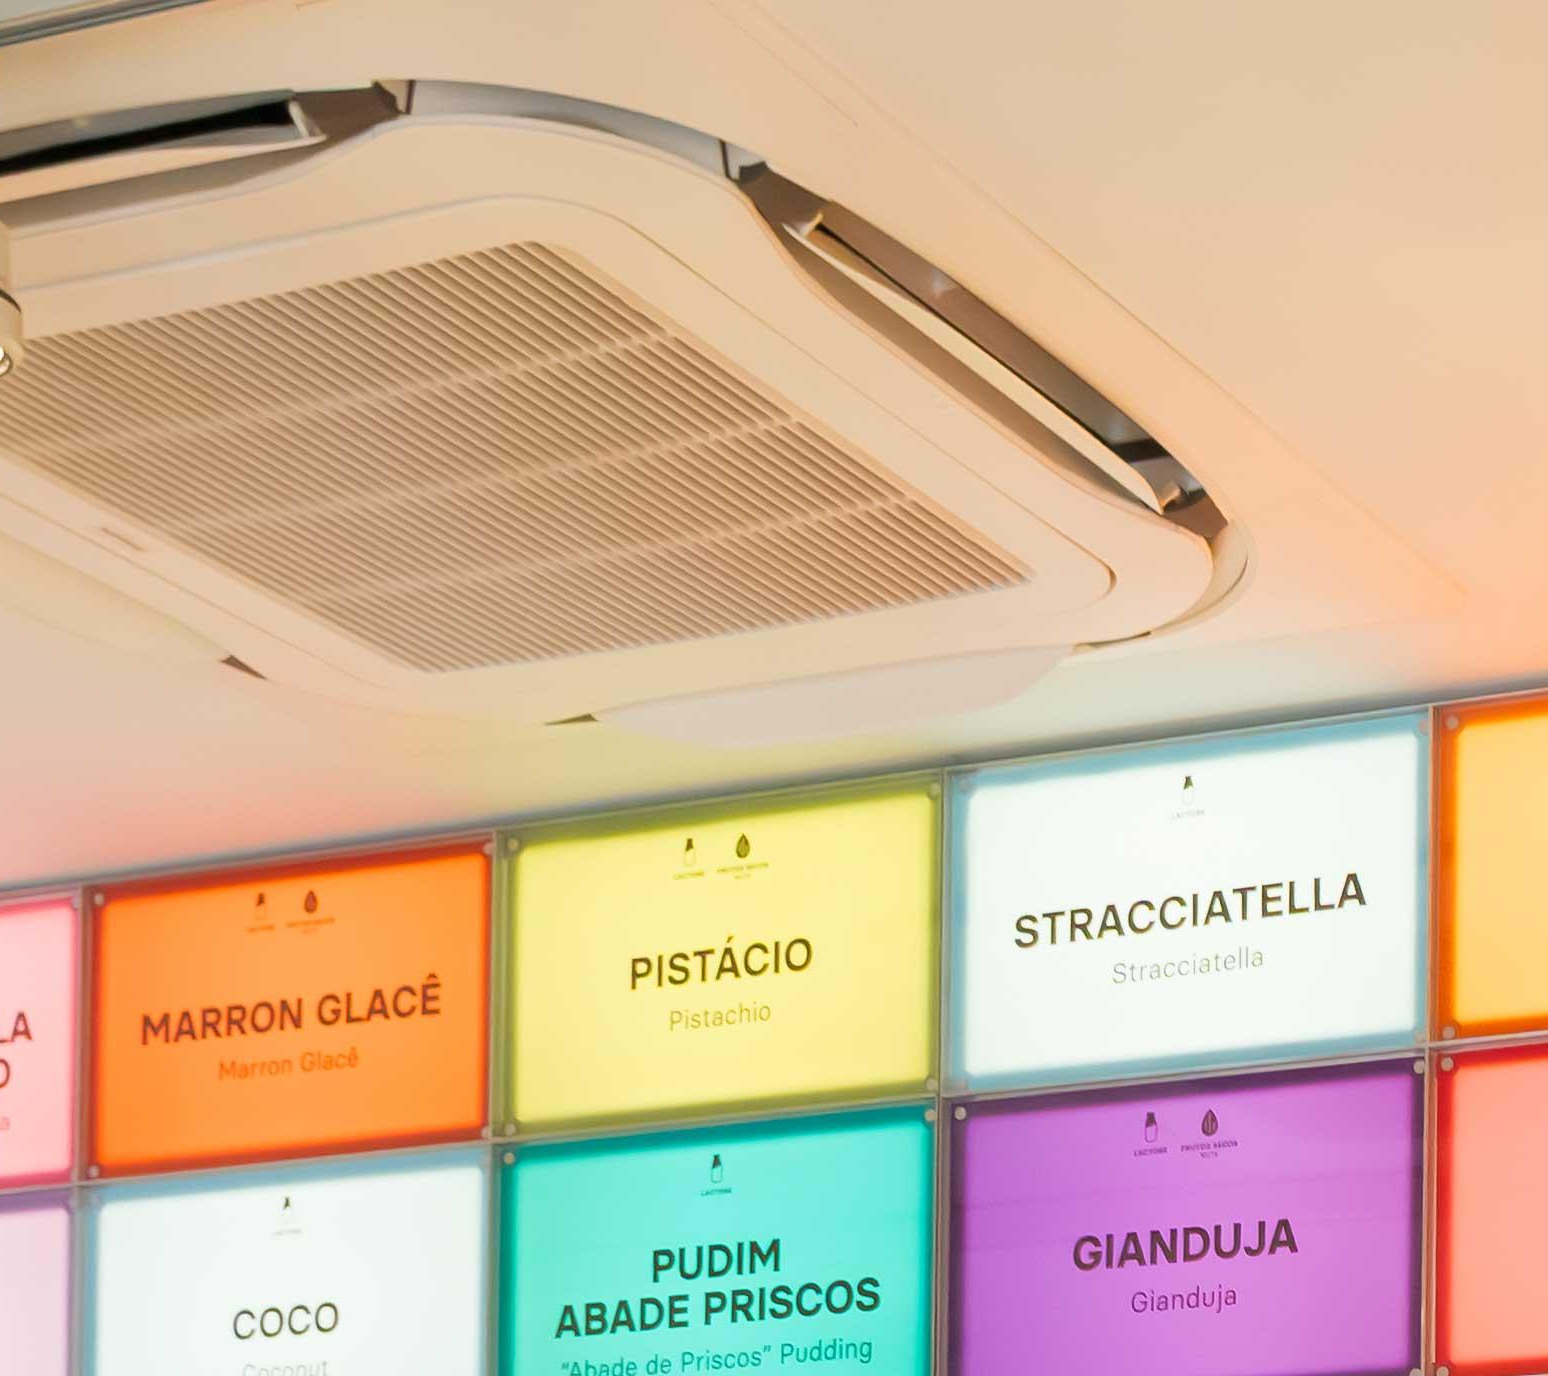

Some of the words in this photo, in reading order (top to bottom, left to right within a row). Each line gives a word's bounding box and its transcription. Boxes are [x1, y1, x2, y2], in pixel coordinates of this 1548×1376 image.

[1013, 873, 1366, 948] STRACCIATELLA
[630, 936, 812, 990] PISTÁCIO
[1111, 947, 1263, 983] Stracciatella
[141, 998, 302, 1045] MARRON
[669, 1002, 771, 1031] Pistachio
[218, 1059, 292, 1080] Marron
[651, 1239, 780, 1282] PUDIM
[1072, 1219, 1298, 1270] GIANDUJA
[555, 1289, 689, 1338] ABADE
[703, 1277, 879, 1325] PRISCOS
[1131, 1284, 1236, 1313] Gianduja
[233, 1303, 338, 1339] COCO
[645, 1354, 671, 1375] de
[779, 1338, 872, 1368] Pudding
